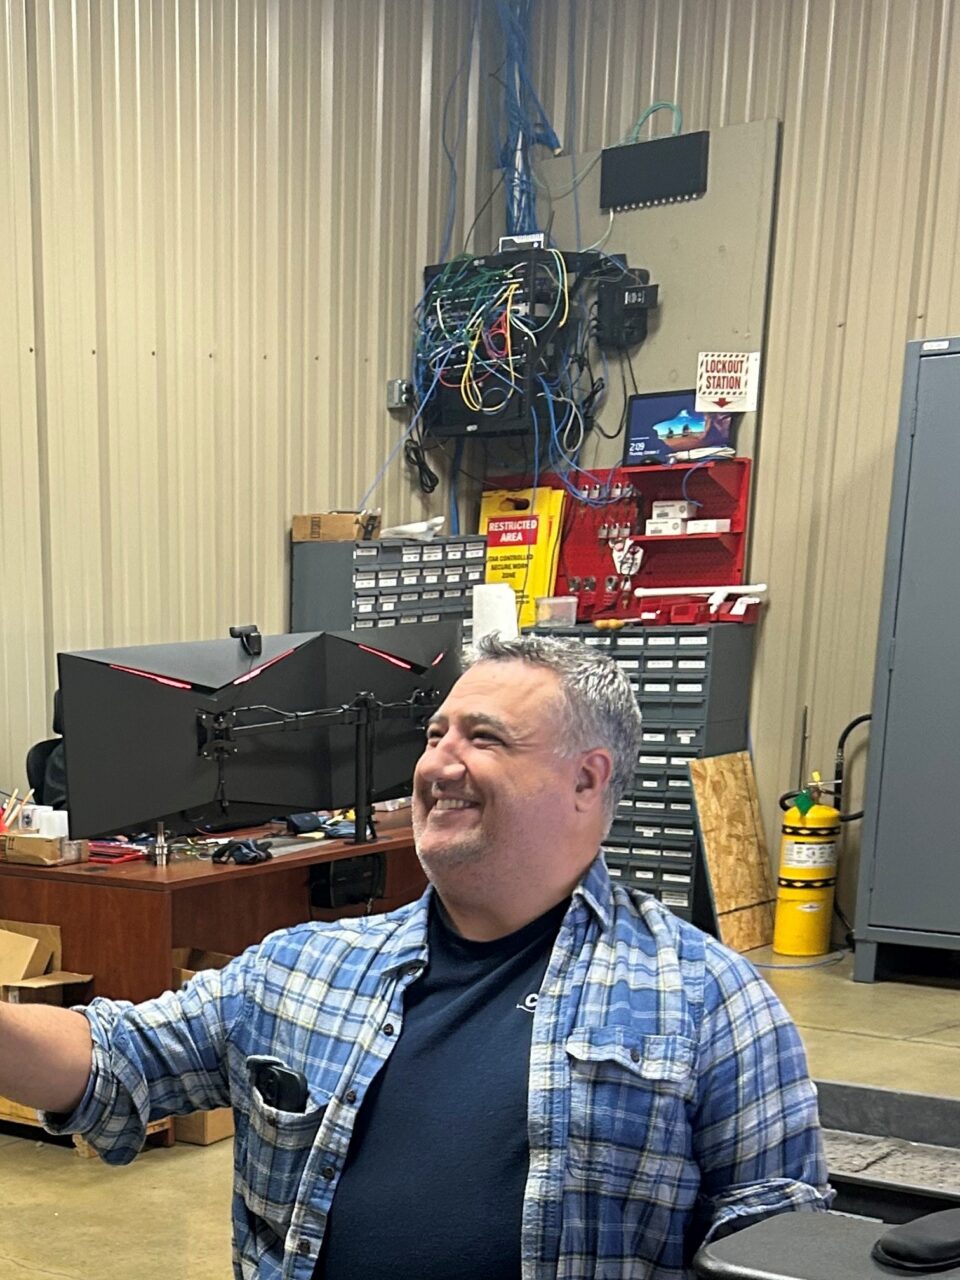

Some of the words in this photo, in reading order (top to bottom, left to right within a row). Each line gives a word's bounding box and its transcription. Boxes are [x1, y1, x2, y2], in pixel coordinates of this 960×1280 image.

[705, 359, 744, 374] LOCKOUT
[705, 375, 741, 390] STATION
[629, 442, 645, 452] 2:09
[488, 519, 537, 531] RESTRICTED
[500, 532, 523, 542] AREA
